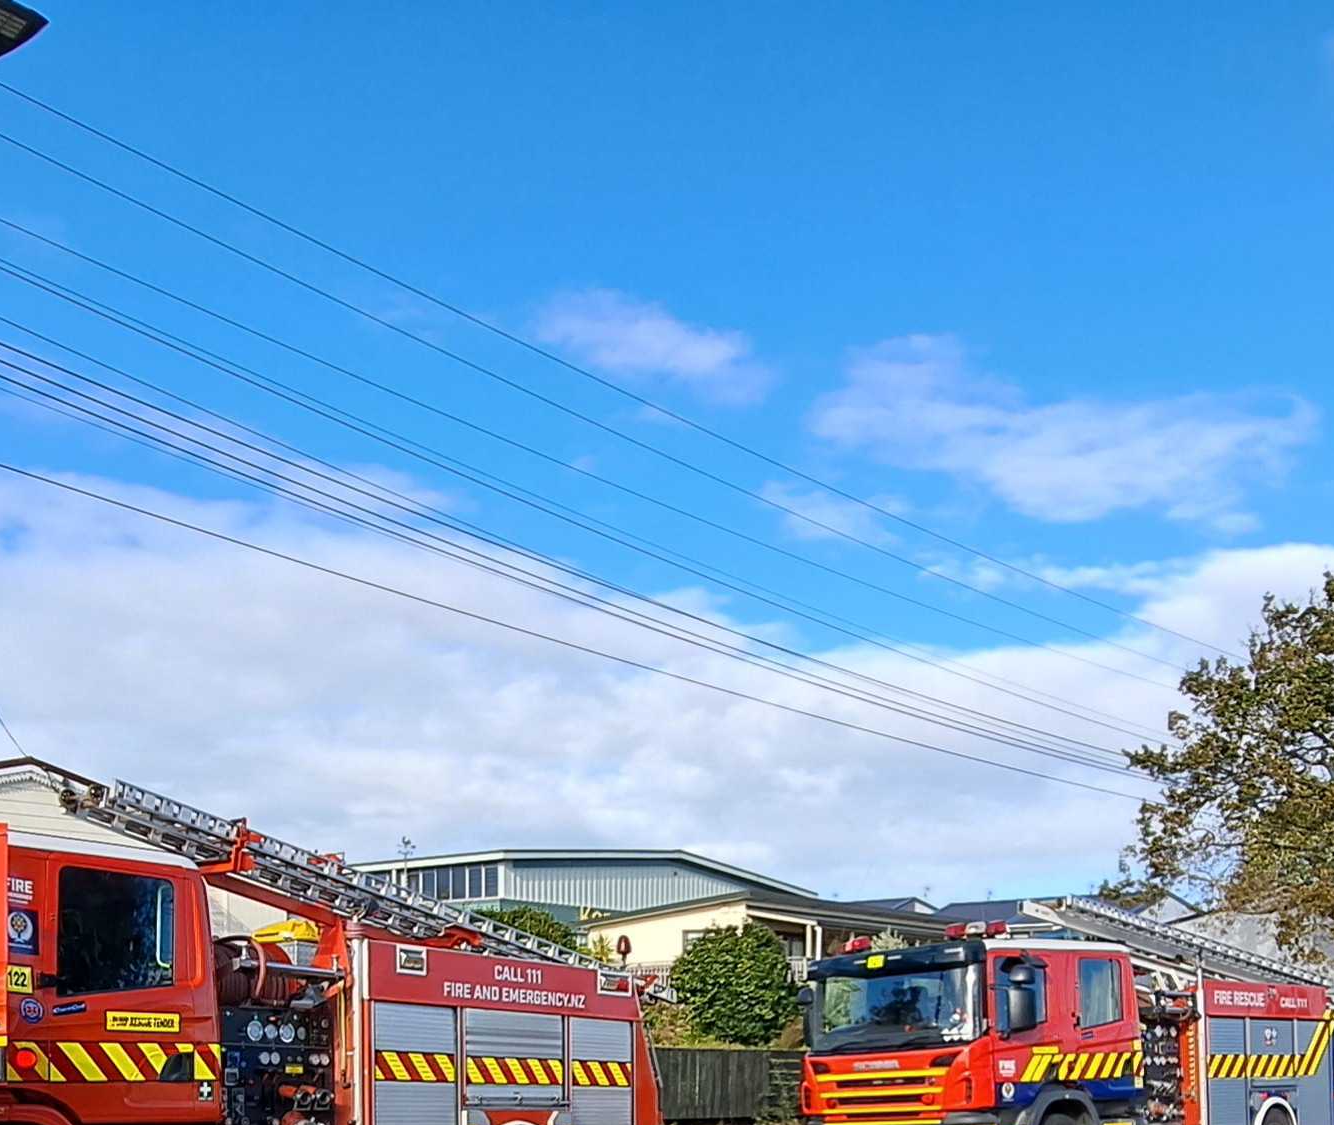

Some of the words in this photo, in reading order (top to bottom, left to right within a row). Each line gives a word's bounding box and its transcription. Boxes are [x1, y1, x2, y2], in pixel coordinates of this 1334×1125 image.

[8, 971, 27, 987] 122
[494, 964, 524, 983] CALL
[527, 968, 542, 985] 111
[443, 982, 471, 998] FIRE
[474, 984, 499, 1000] AND
[501, 986, 585, 1009] EMERGENCY.NZ
[1213, 990, 1232, 1005] FIRE
[1233, 991, 1266, 1007] RESCUE
